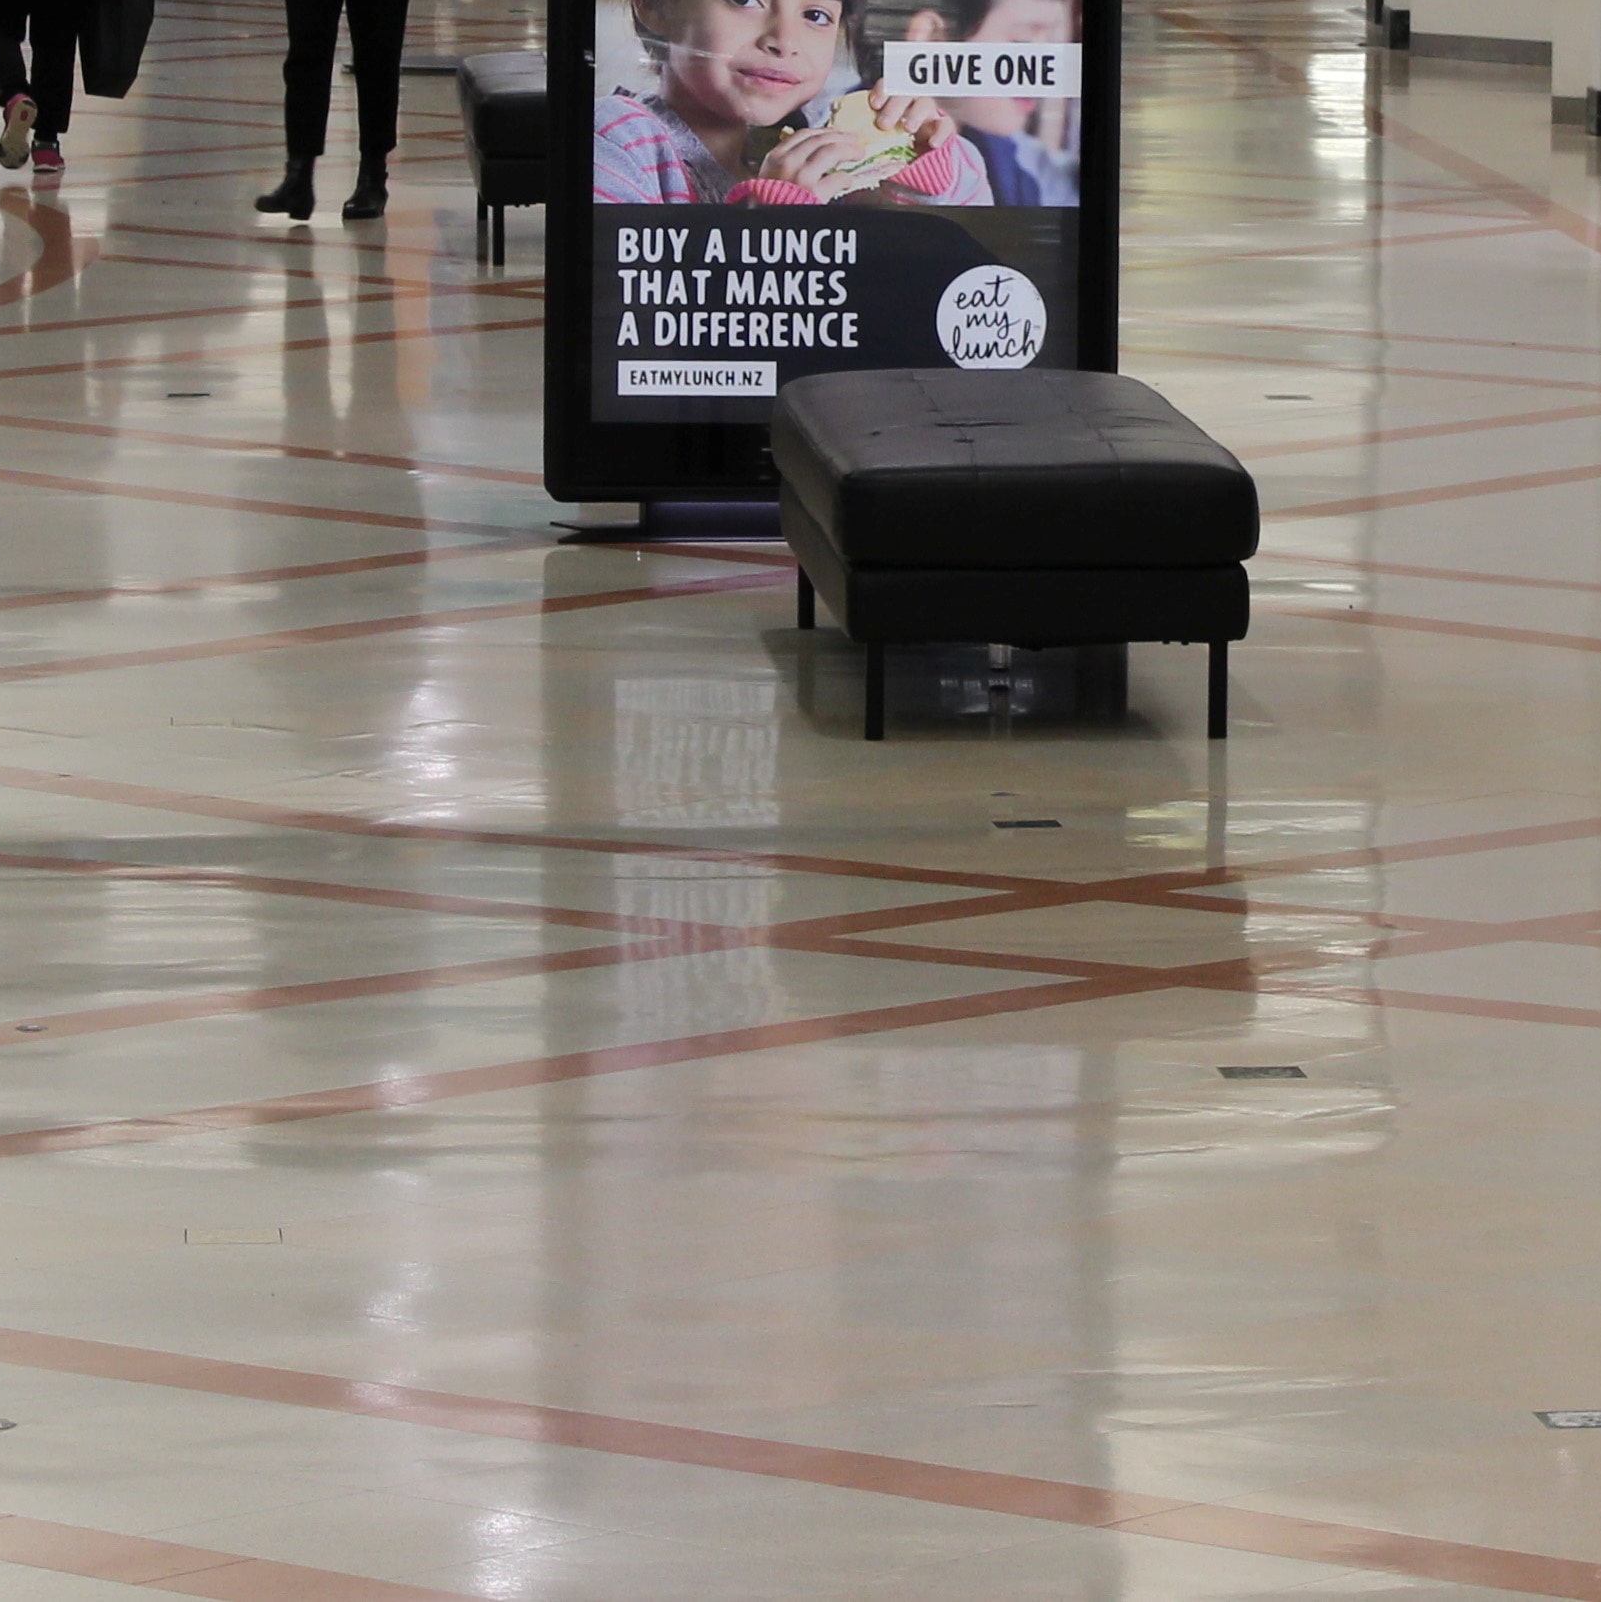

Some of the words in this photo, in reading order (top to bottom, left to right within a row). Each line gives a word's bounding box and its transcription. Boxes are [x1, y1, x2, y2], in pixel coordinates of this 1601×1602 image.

[908, 54, 982, 85] GIVE
[994, 54, 1056, 86] ONE
[617, 227, 689, 264] BUY
[703, 228, 726, 264] A
[741, 228, 857, 265] LUNCH
[617, 269, 712, 305] THAT
[726, 270, 848, 306] MAKES
[953, 274, 1014, 311] eat
[617, 311, 640, 346] A
[654, 311, 859, 347] DIFFERENCE
[947, 319, 1038, 362] lunch
[965, 310, 1021, 339] my
[630, 370, 764, 387] EATMYLUNCH.NZ
